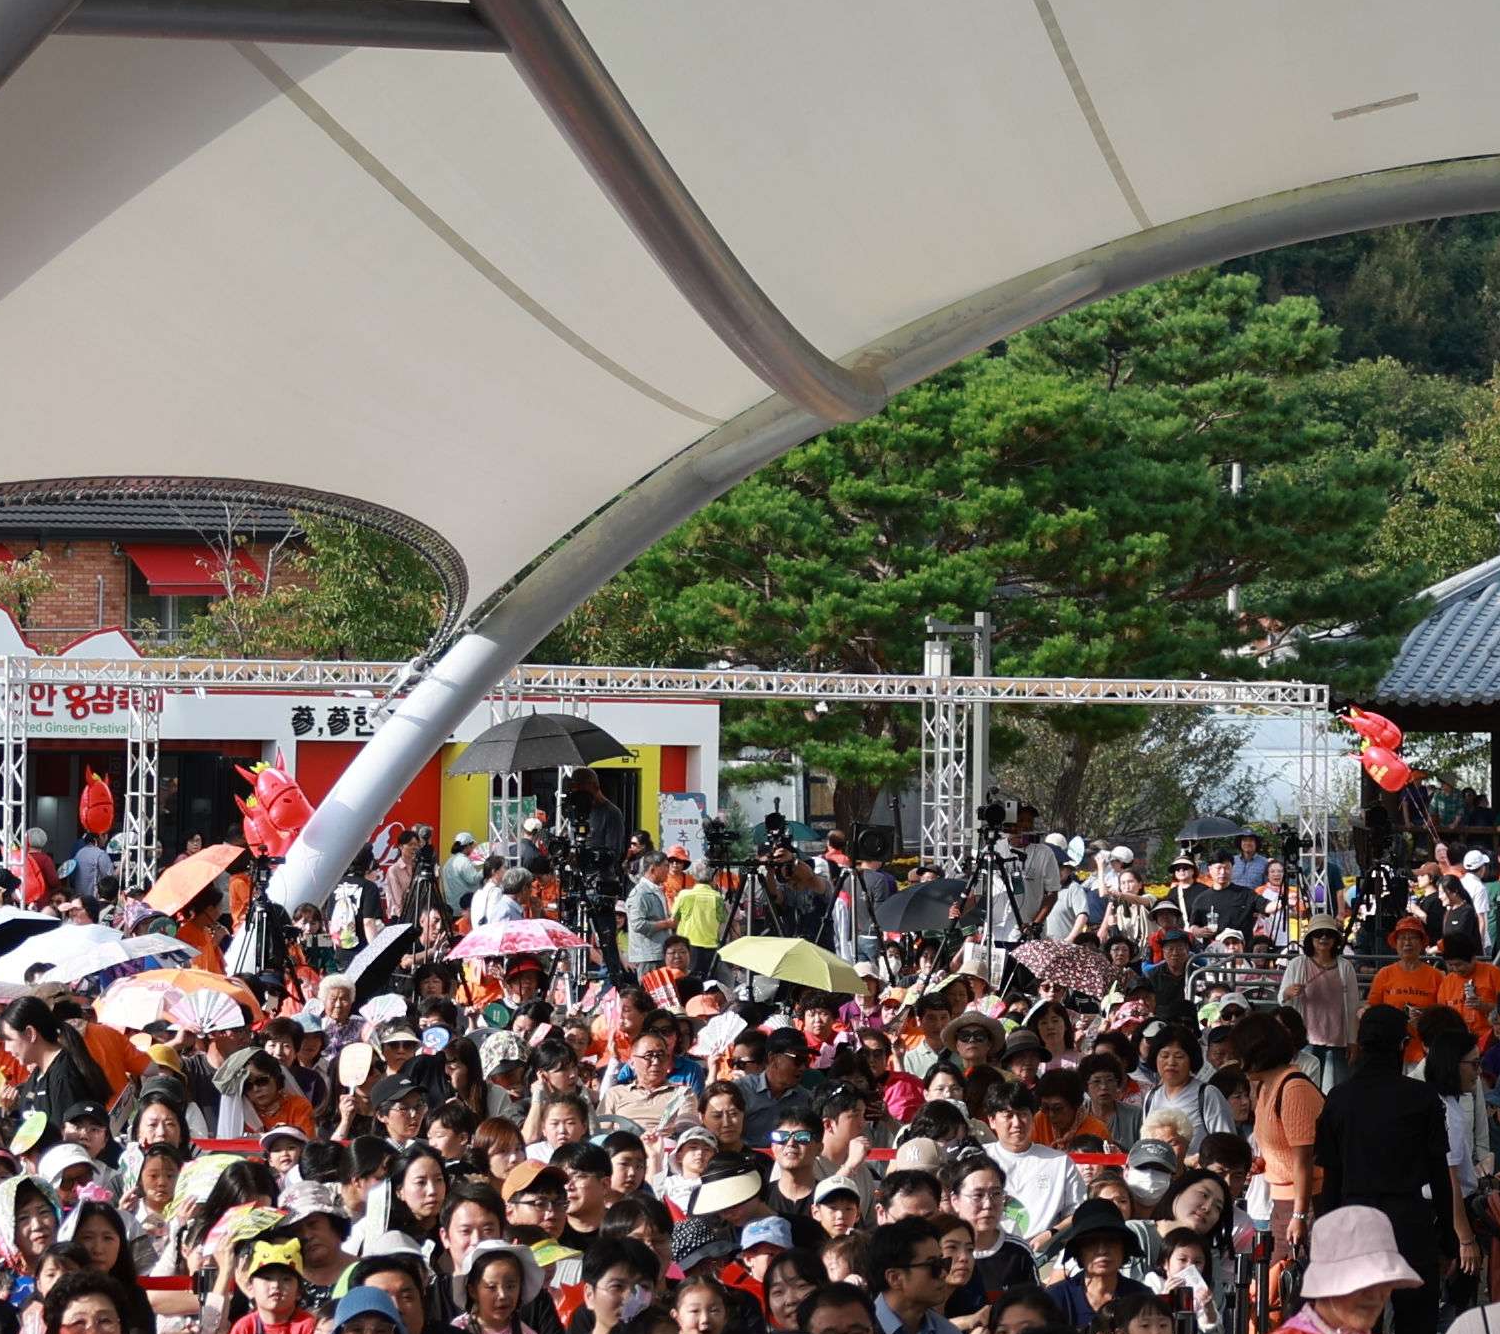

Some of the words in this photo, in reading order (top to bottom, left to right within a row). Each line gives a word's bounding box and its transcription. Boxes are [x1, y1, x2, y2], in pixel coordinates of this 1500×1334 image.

[45, 722, 88, 735] Ginseng
[90, 723, 128, 734] Festival
[906, 1149, 920, 1161] NY
